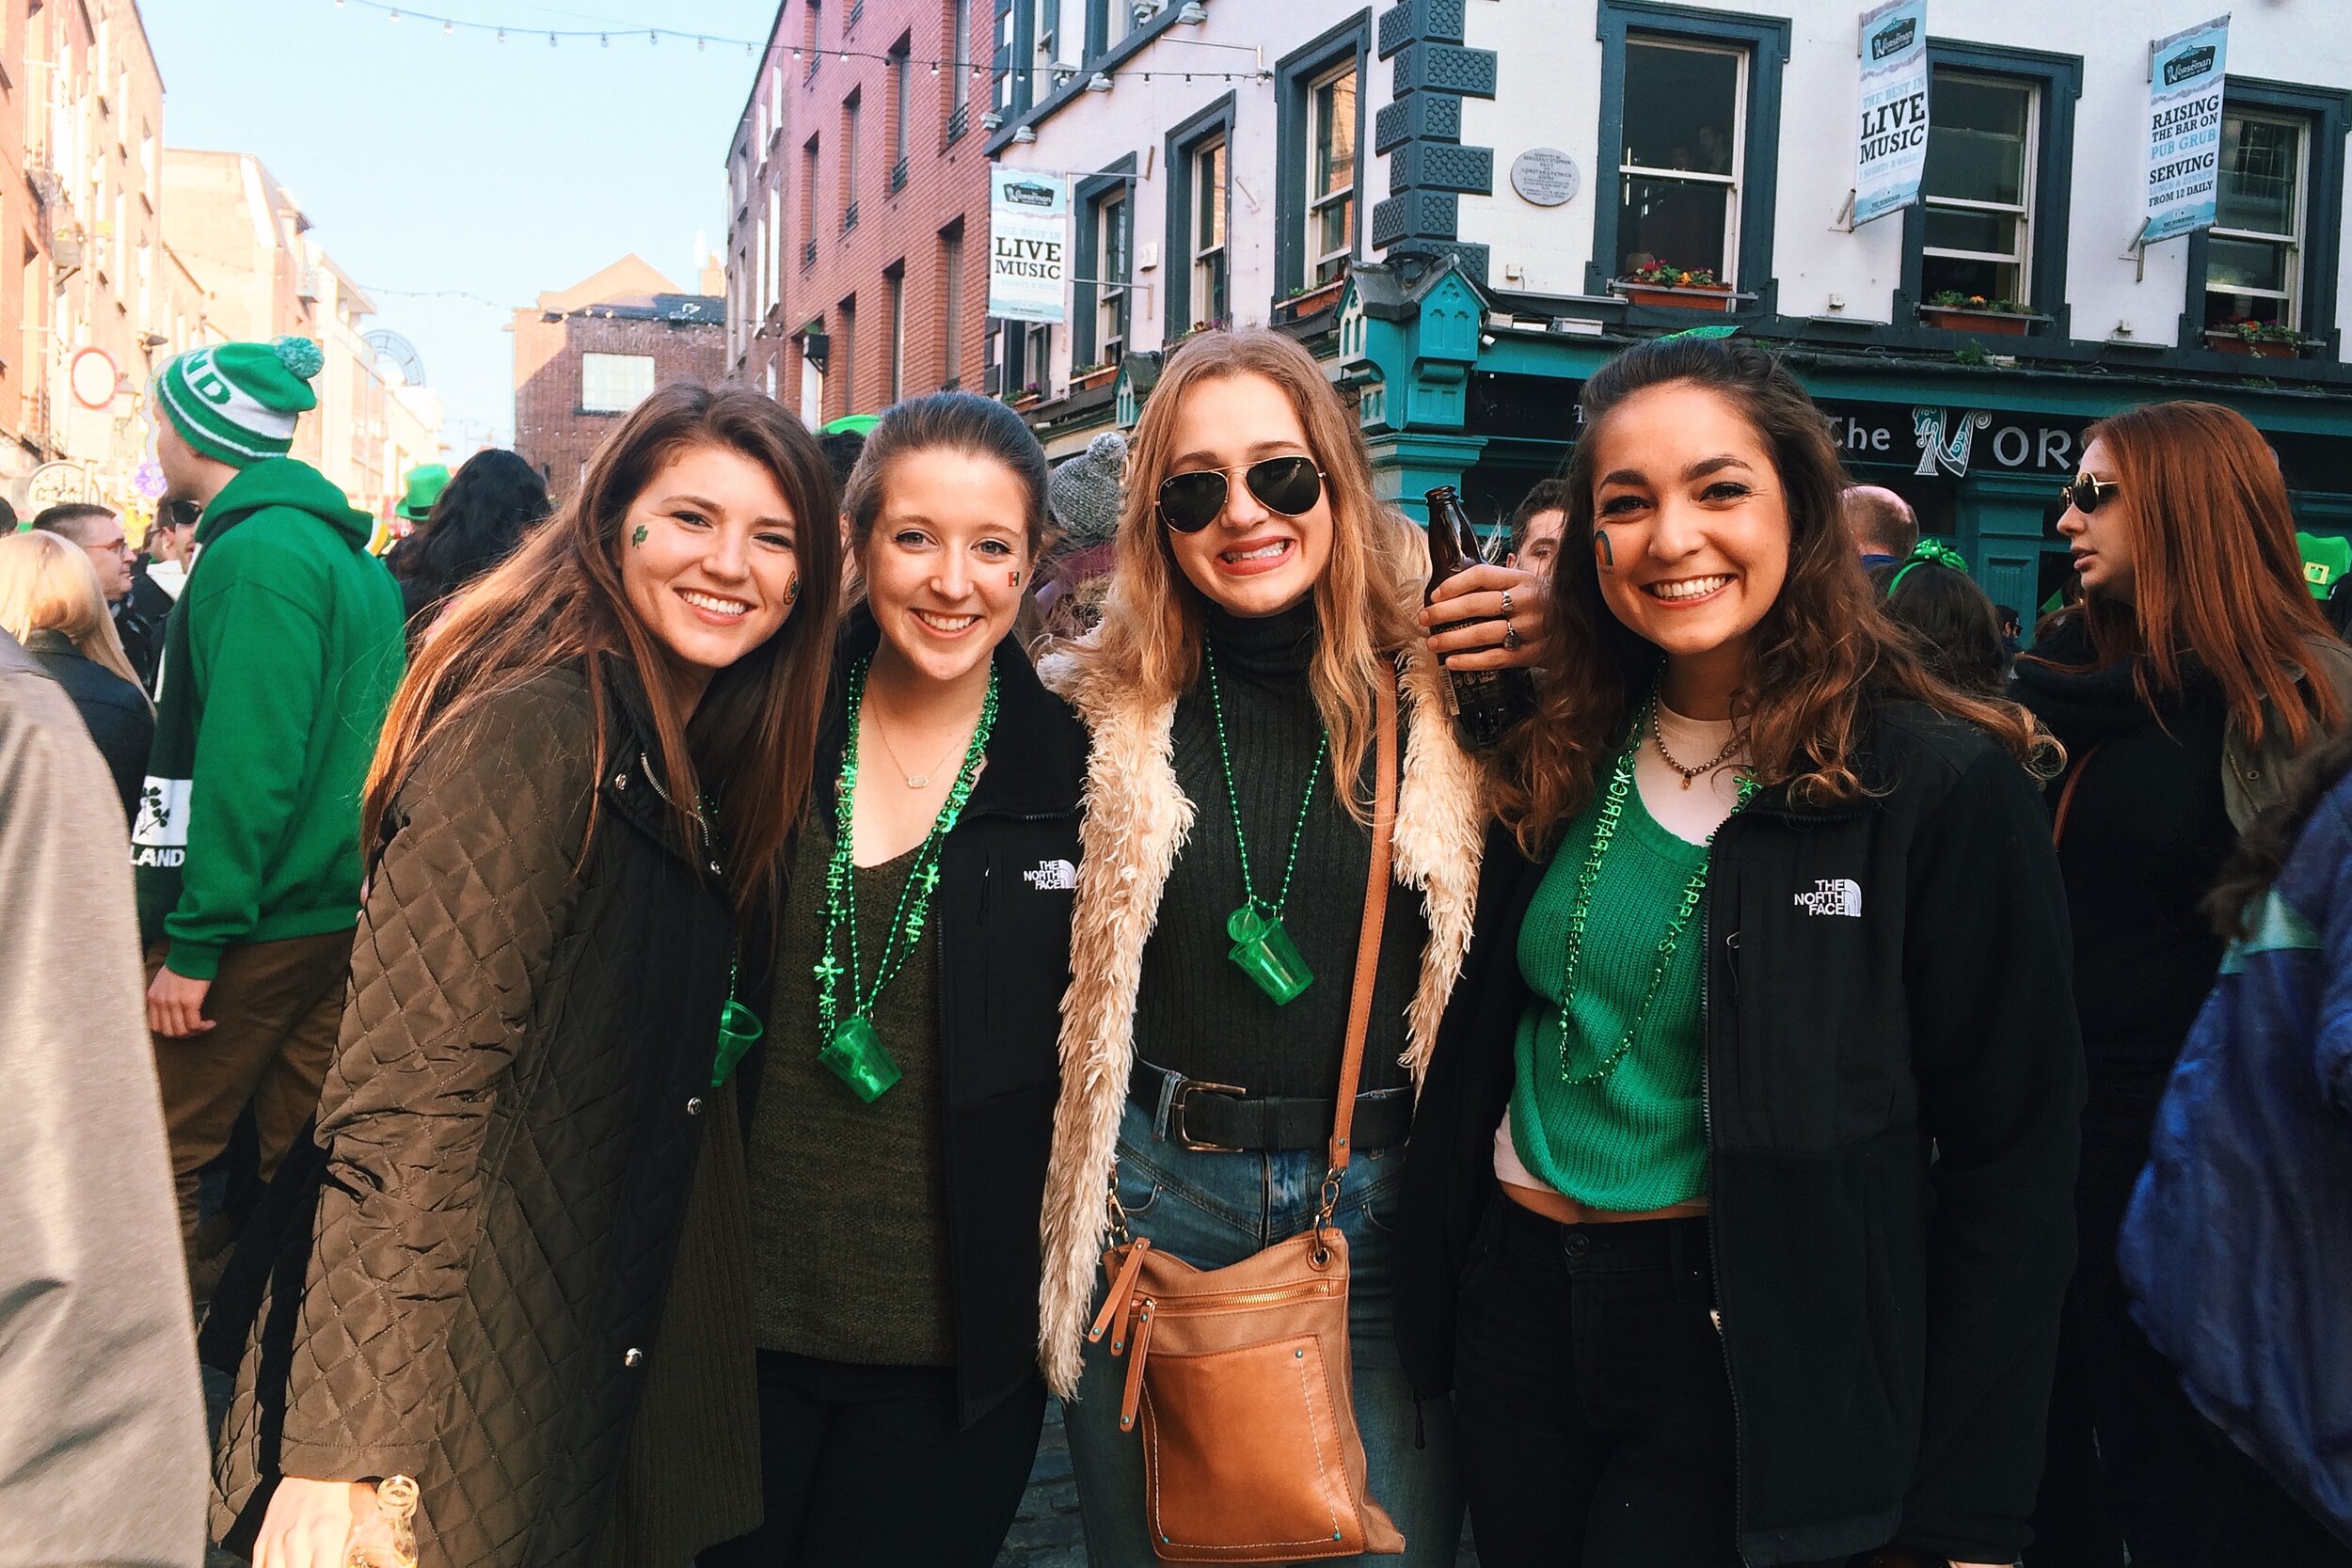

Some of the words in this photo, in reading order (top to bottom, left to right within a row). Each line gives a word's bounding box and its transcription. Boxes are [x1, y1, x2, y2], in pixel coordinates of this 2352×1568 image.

[1861, 91, 1926, 140] LIVE
[2152, 94, 2219, 131] RAISING
[2152, 127, 2173, 143] THE
[2175, 119, 2198, 135] BAR
[2201, 112, 2218, 127] ON
[1860, 124, 1925, 165] MUSIC
[2151, 140, 2175, 159] PUB
[2179, 128, 2217, 150] GRUB
[2150, 151, 2215, 184] SERVING
[2148, 192, 2174, 207] FROM
[2176, 188, 2185, 199] 12
[2186, 180, 2214, 197] DAILY
[995, 236, 1061, 262] LIVE
[995, 260, 1061, 279] MUSIC
[186, 347, 232, 405] ND
[129, 846, 186, 866] LAND
[1039, 860, 1059, 870] THE
[1024, 870, 1060, 881] NORTH
[1035, 879, 1061, 890] FACE
[1814, 879, 1845, 892] THE
[1793, 891, 1845, 906] NORTH
[1808, 903, 1845, 916] FACE
